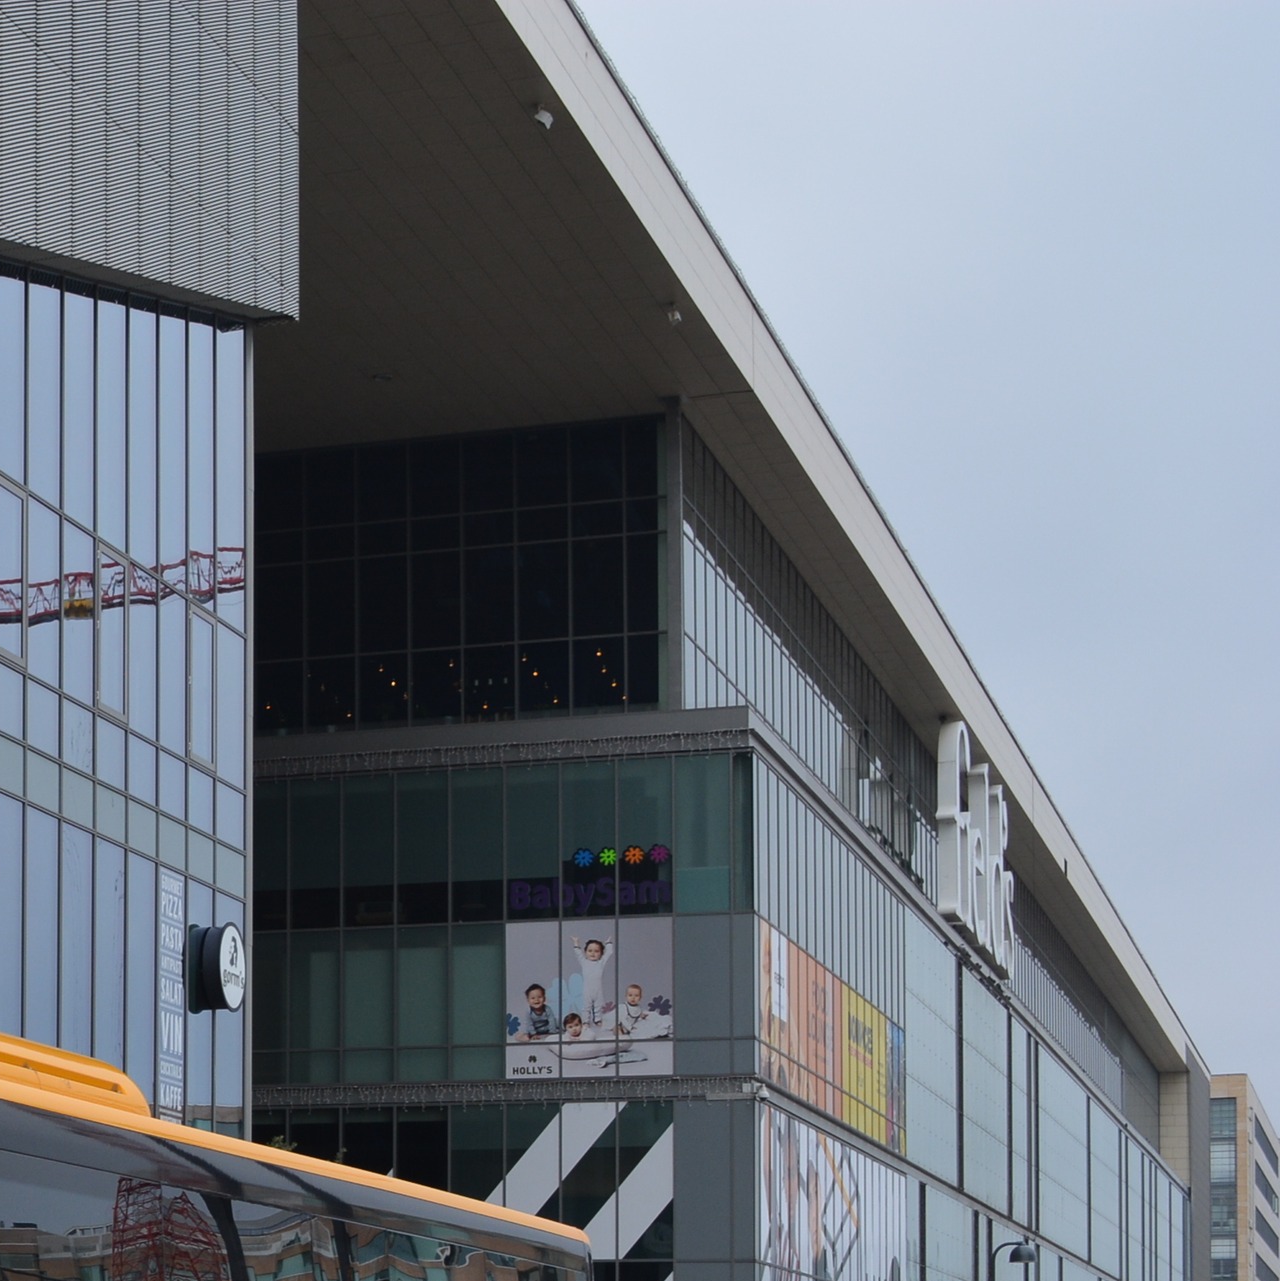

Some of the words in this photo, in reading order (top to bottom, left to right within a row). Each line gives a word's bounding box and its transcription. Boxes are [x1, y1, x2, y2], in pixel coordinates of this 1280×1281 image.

[161, 891, 183, 921] PIZZA
[510, 876, 673, 915] BabySam
[161, 923, 183, 954] PASTA
[161, 977, 183, 1006] SALAT
[223, 969, 244, 989] gorm's
[161, 1011, 182, 1056] VIN
[160, 1060, 182, 1079] COCKTAILS
[512, 1066, 553, 1076] HOLLY'S
[160, 1082, 182, 1111] KAFFE
